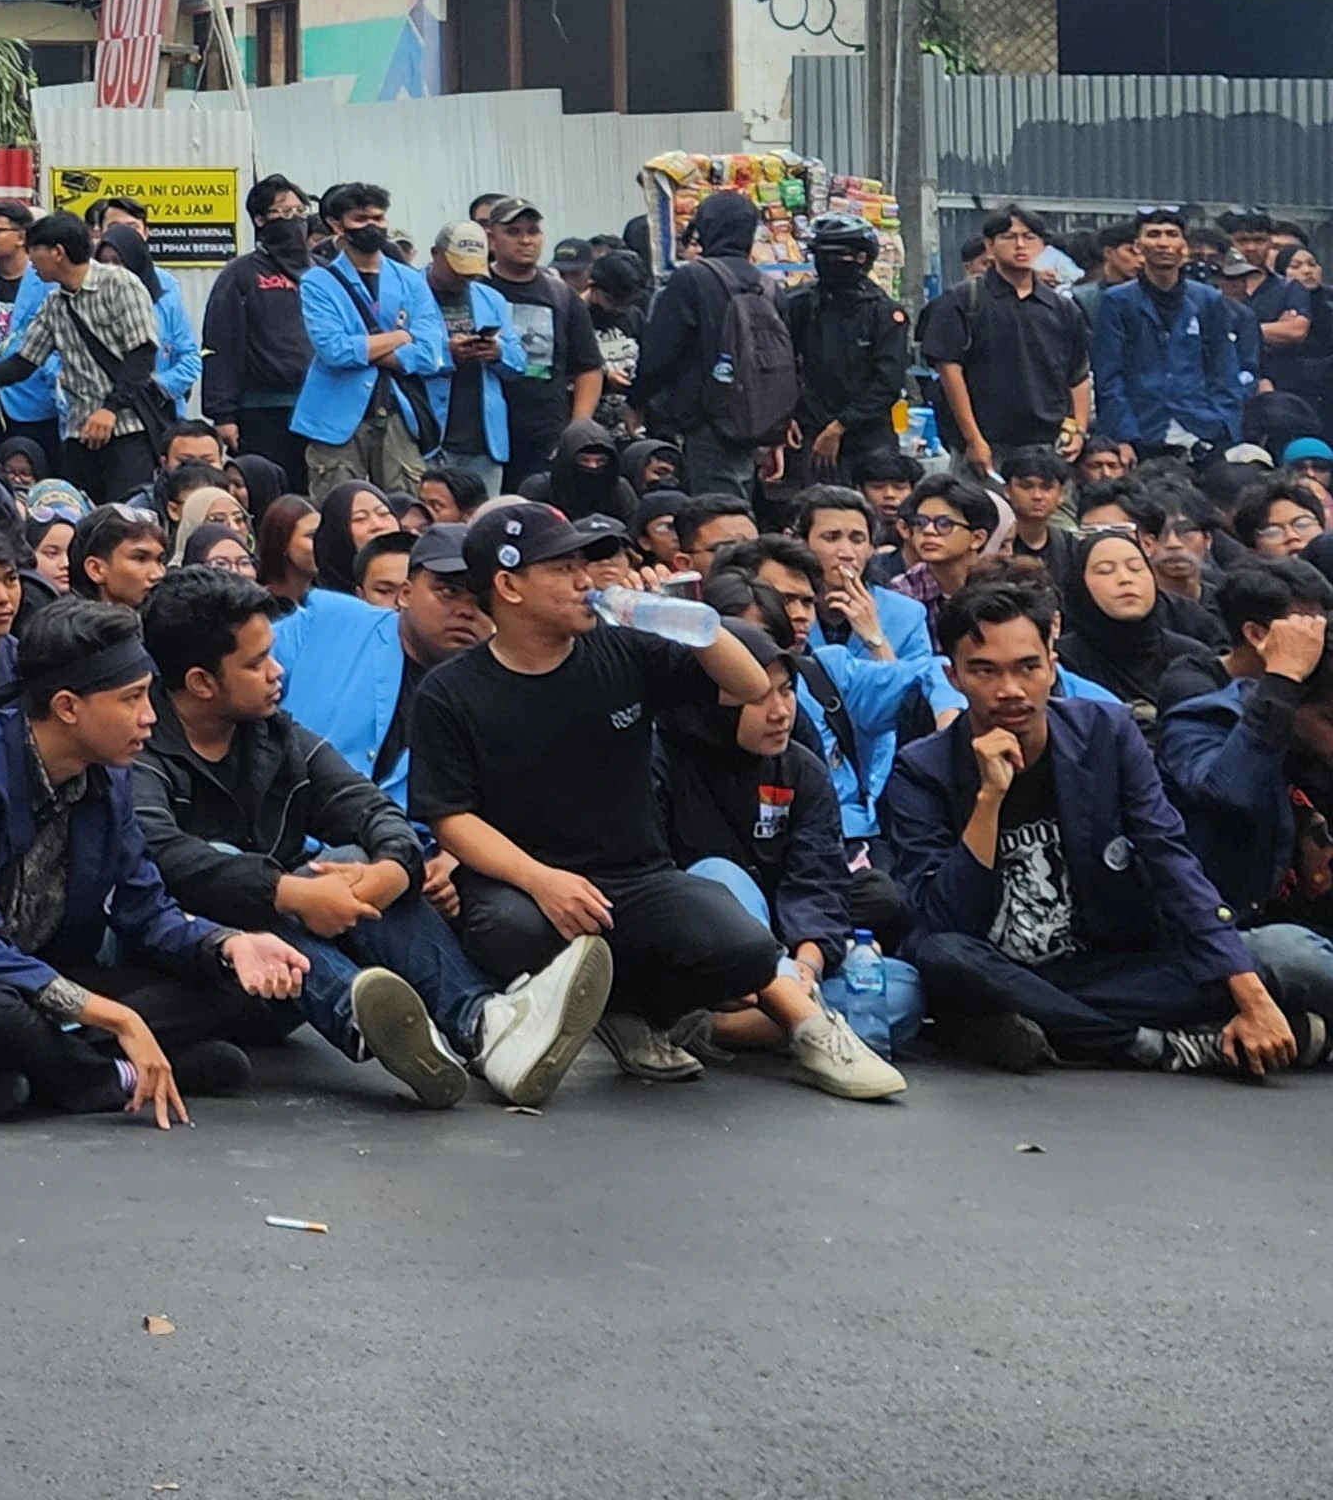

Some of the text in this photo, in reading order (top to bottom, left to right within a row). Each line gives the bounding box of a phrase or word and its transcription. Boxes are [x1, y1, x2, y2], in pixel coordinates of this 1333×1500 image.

[104, 183, 230, 197] AREA INI DIAWASI
[165, 203, 181, 216] 24
[184, 203, 214, 216] JAM
[162, 243, 191, 254] PIHAK
